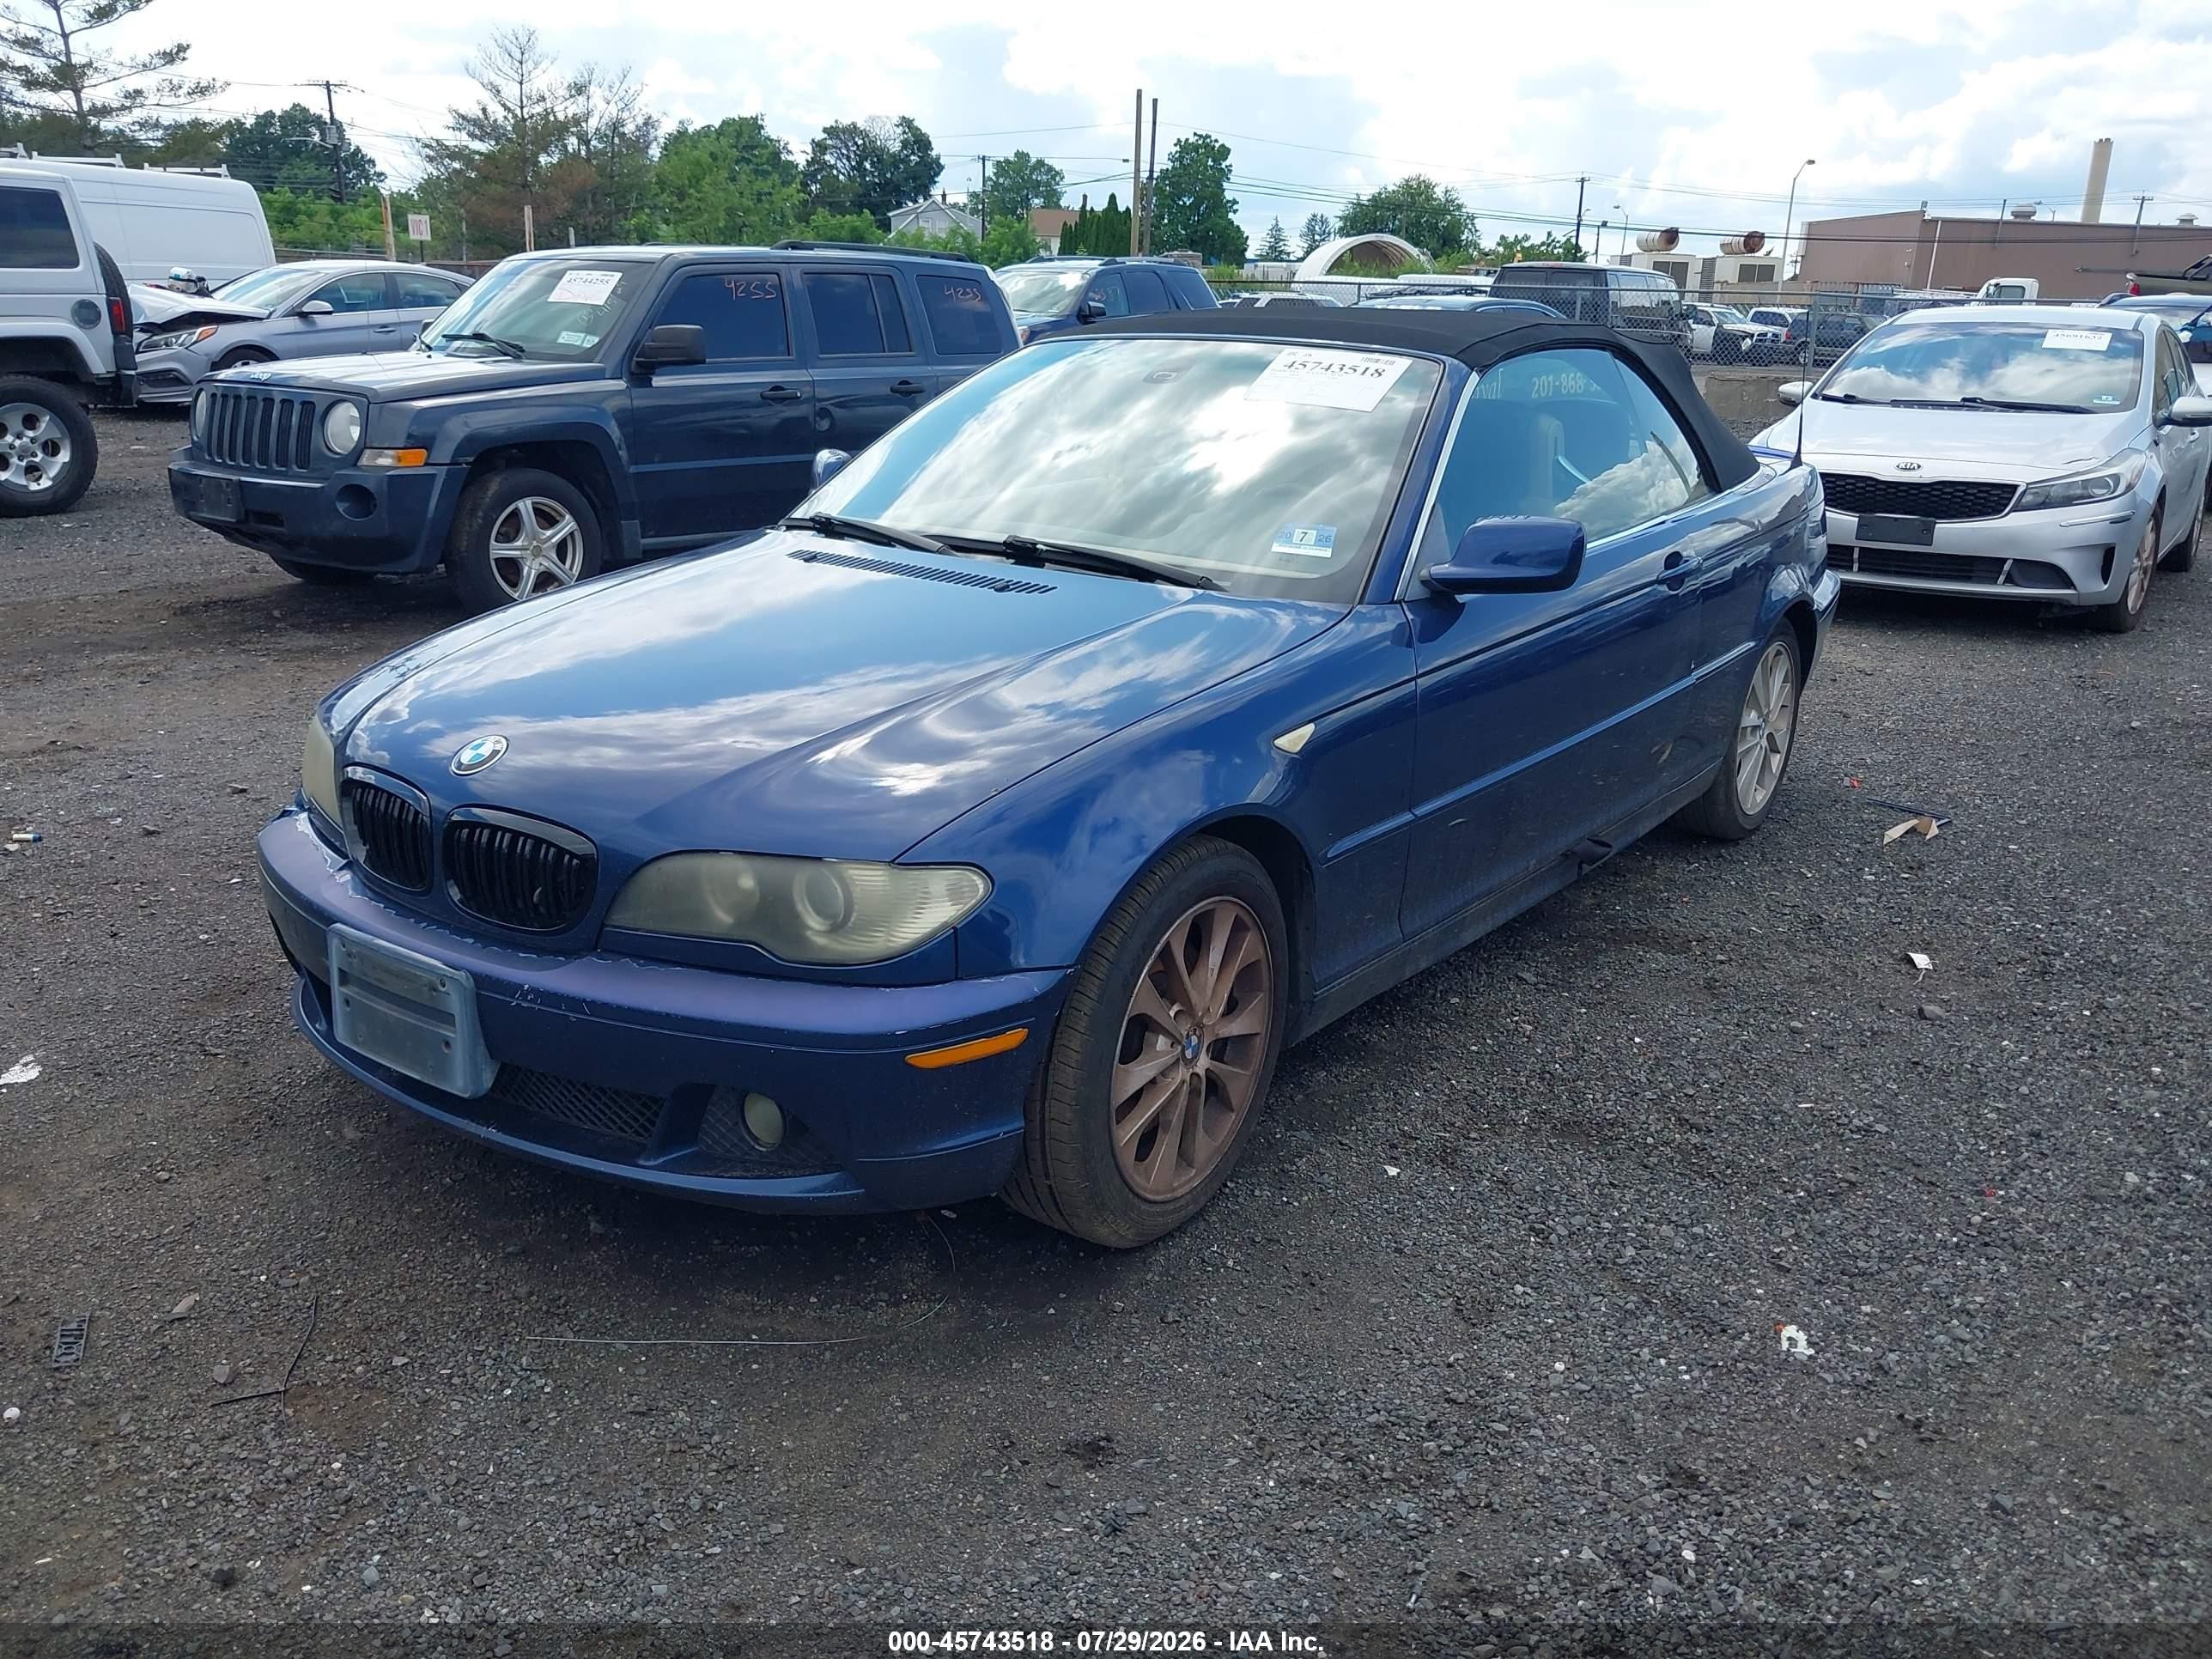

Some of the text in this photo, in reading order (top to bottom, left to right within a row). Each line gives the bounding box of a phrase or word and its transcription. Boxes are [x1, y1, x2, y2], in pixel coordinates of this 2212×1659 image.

[725, 276, 777, 301] 4255
[1283, 359, 1386, 379] 45743518
[1278, 531, 1332, 543] 20 7 26
